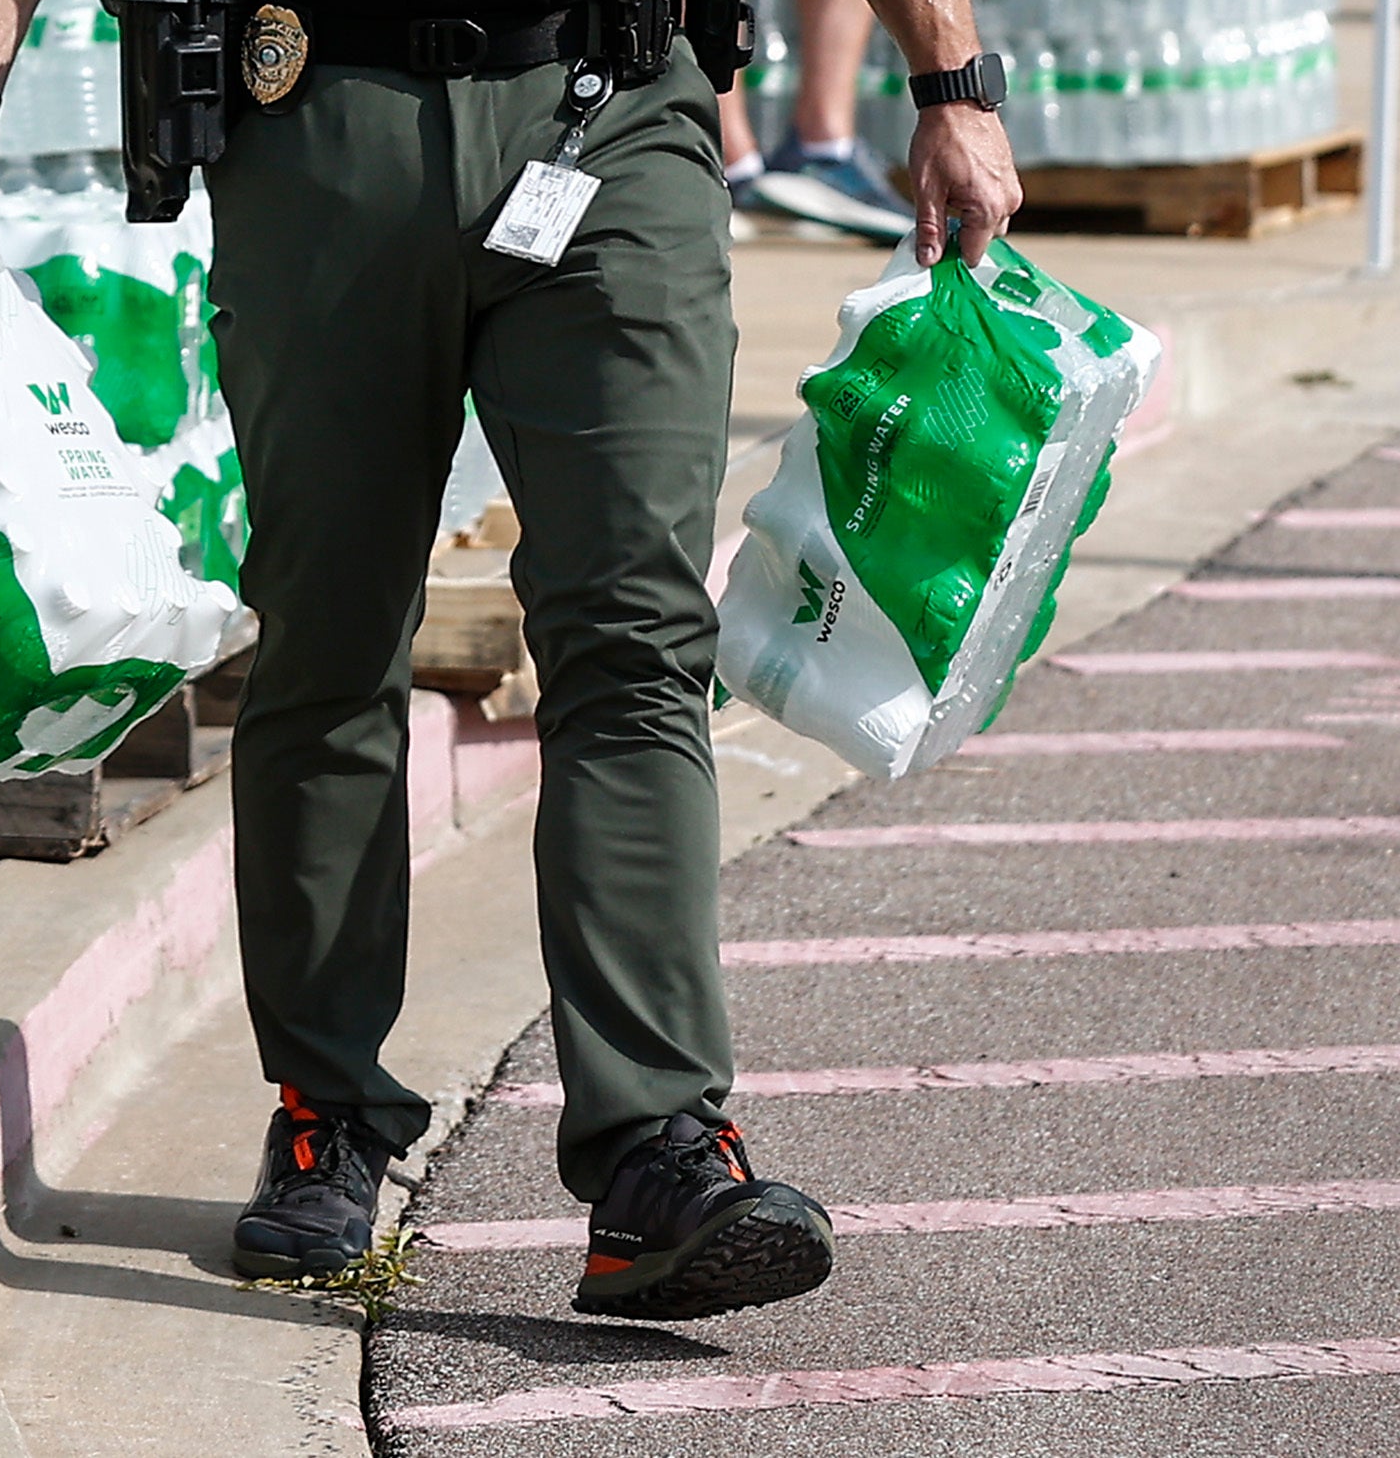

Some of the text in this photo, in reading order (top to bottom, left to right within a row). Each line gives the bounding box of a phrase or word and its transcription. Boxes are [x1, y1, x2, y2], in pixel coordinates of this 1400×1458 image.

[45, 422, 90, 435] wesco
[58, 449, 107, 464] SPRING
[845, 459, 879, 532] SPRING
[868, 394, 912, 454] WATER
[65, 466, 115, 481] WATER
[816, 580, 846, 643] wesco
